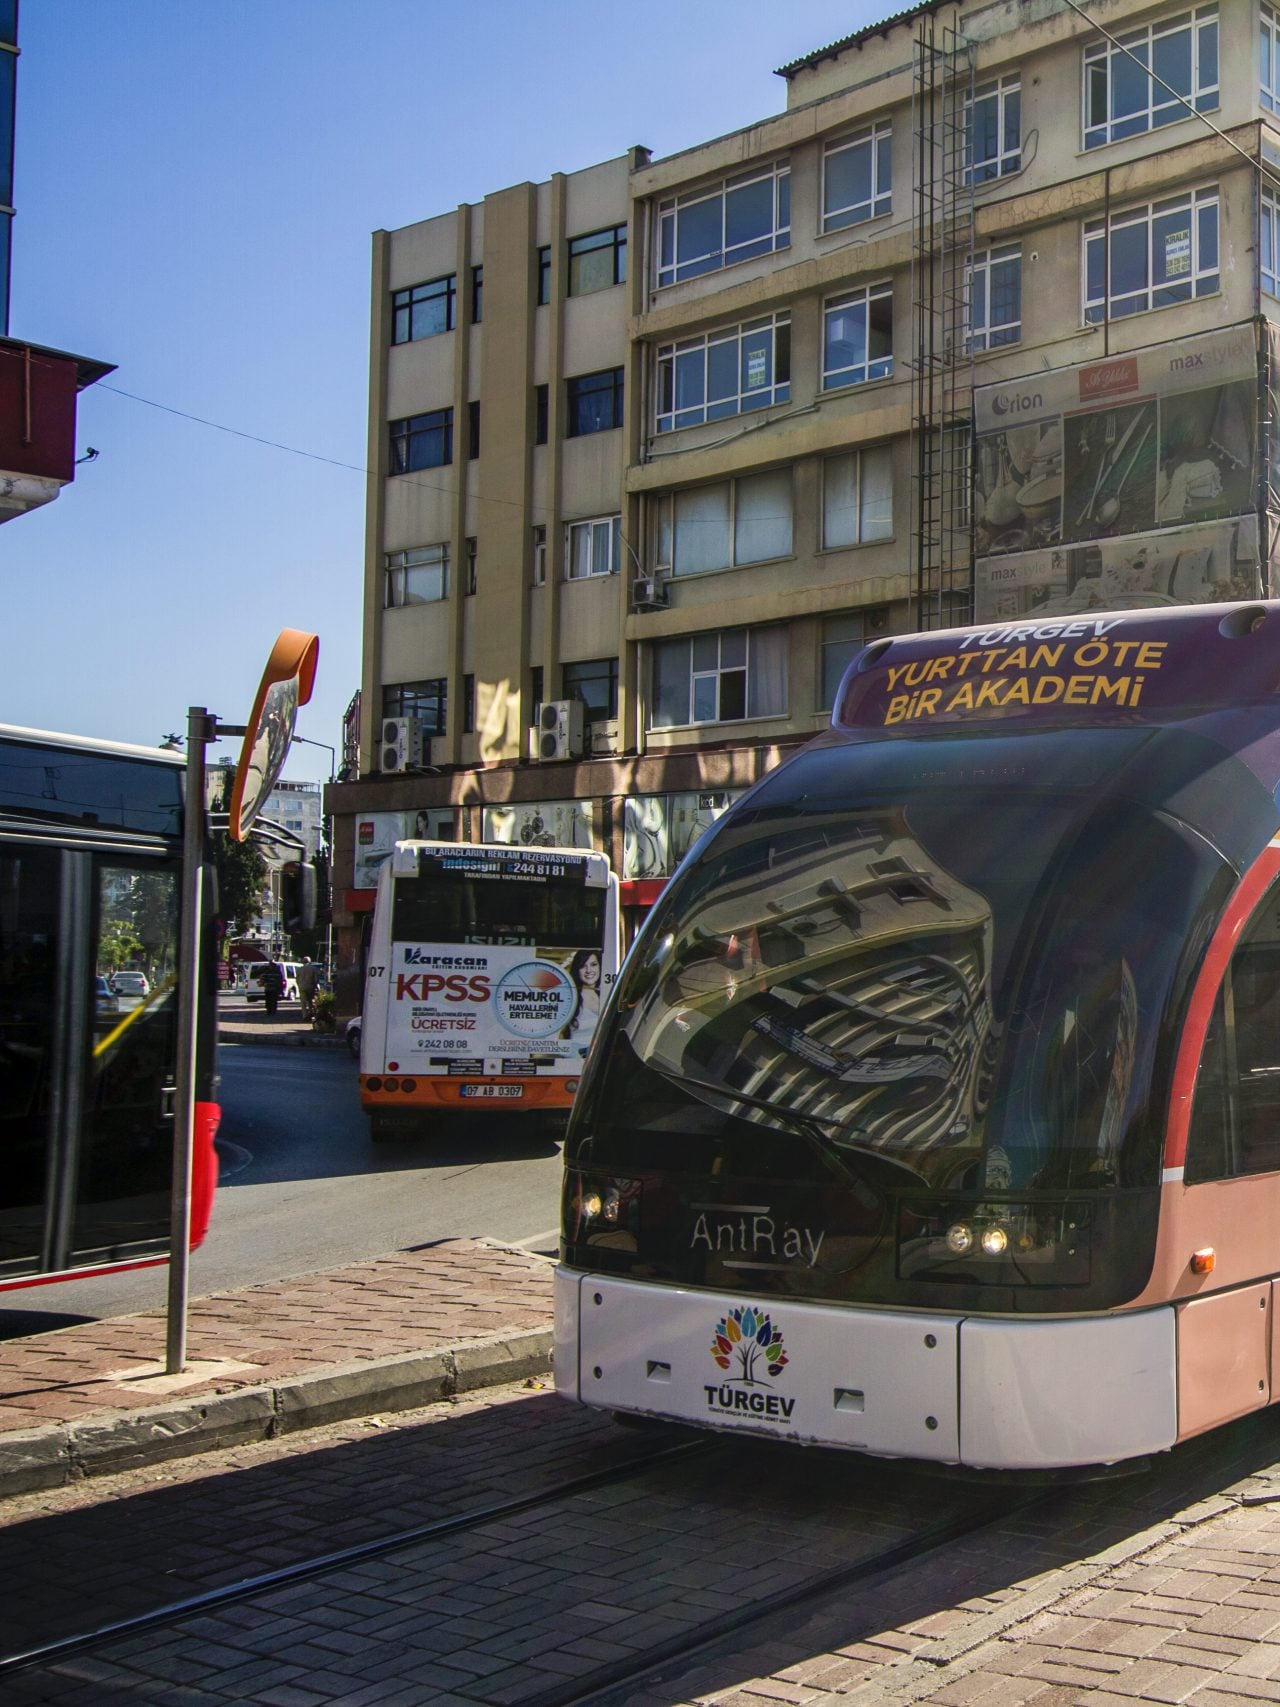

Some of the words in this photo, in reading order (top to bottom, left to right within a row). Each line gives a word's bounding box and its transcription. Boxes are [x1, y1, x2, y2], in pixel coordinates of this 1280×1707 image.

[959, 619, 1126, 649] TÜRGEV
[884, 643, 1066, 692] YURTTAN
[1073, 637, 1168, 668] ÖTE
[513, 862, 537, 875] 244
[537, 864, 550, 876] 81
[552, 865, 565, 876] 81
[404, 947, 488, 966] Karacan
[396, 973, 491, 1003] KPSS
[504, 990, 549, 1003] MEMUR
[549, 992, 564, 1003] OL
[508, 1002, 559, 1012] HAYALLERİNİ
[411, 1016, 476, 1030] ÜCRETSİZ
[424, 1040, 441, 1048] 242
[443, 1040, 454, 1048] 08
[456, 1040, 467, 1048] 08
[466, 1086, 478, 1096] 07
[483, 1086, 495, 1096] AB
[499, 1086, 522, 1097] 0307
[690, 1213, 826, 1269] AntRay
[704, 1384, 796, 1417] TÜRGEV
